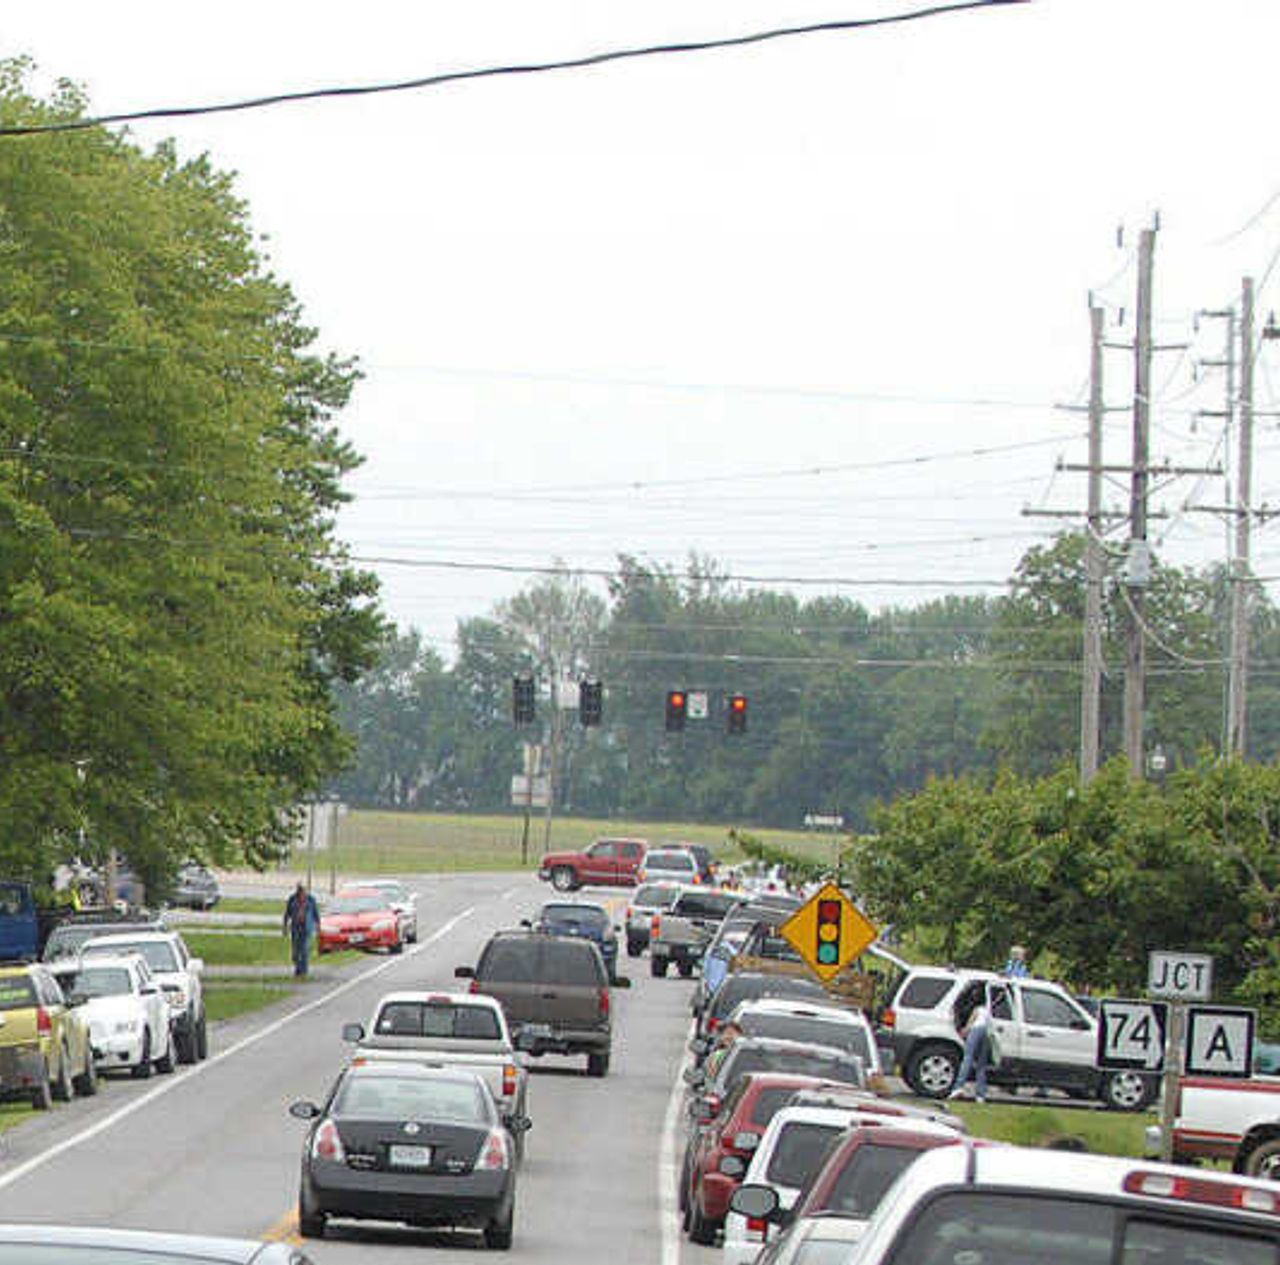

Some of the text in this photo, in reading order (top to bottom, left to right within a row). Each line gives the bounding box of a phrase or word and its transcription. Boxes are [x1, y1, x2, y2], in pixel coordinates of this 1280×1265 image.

[1152, 960, 1205, 992] JCT
[1108, 1012, 1152, 1050] 74
[1204, 1024, 1233, 1062] A
